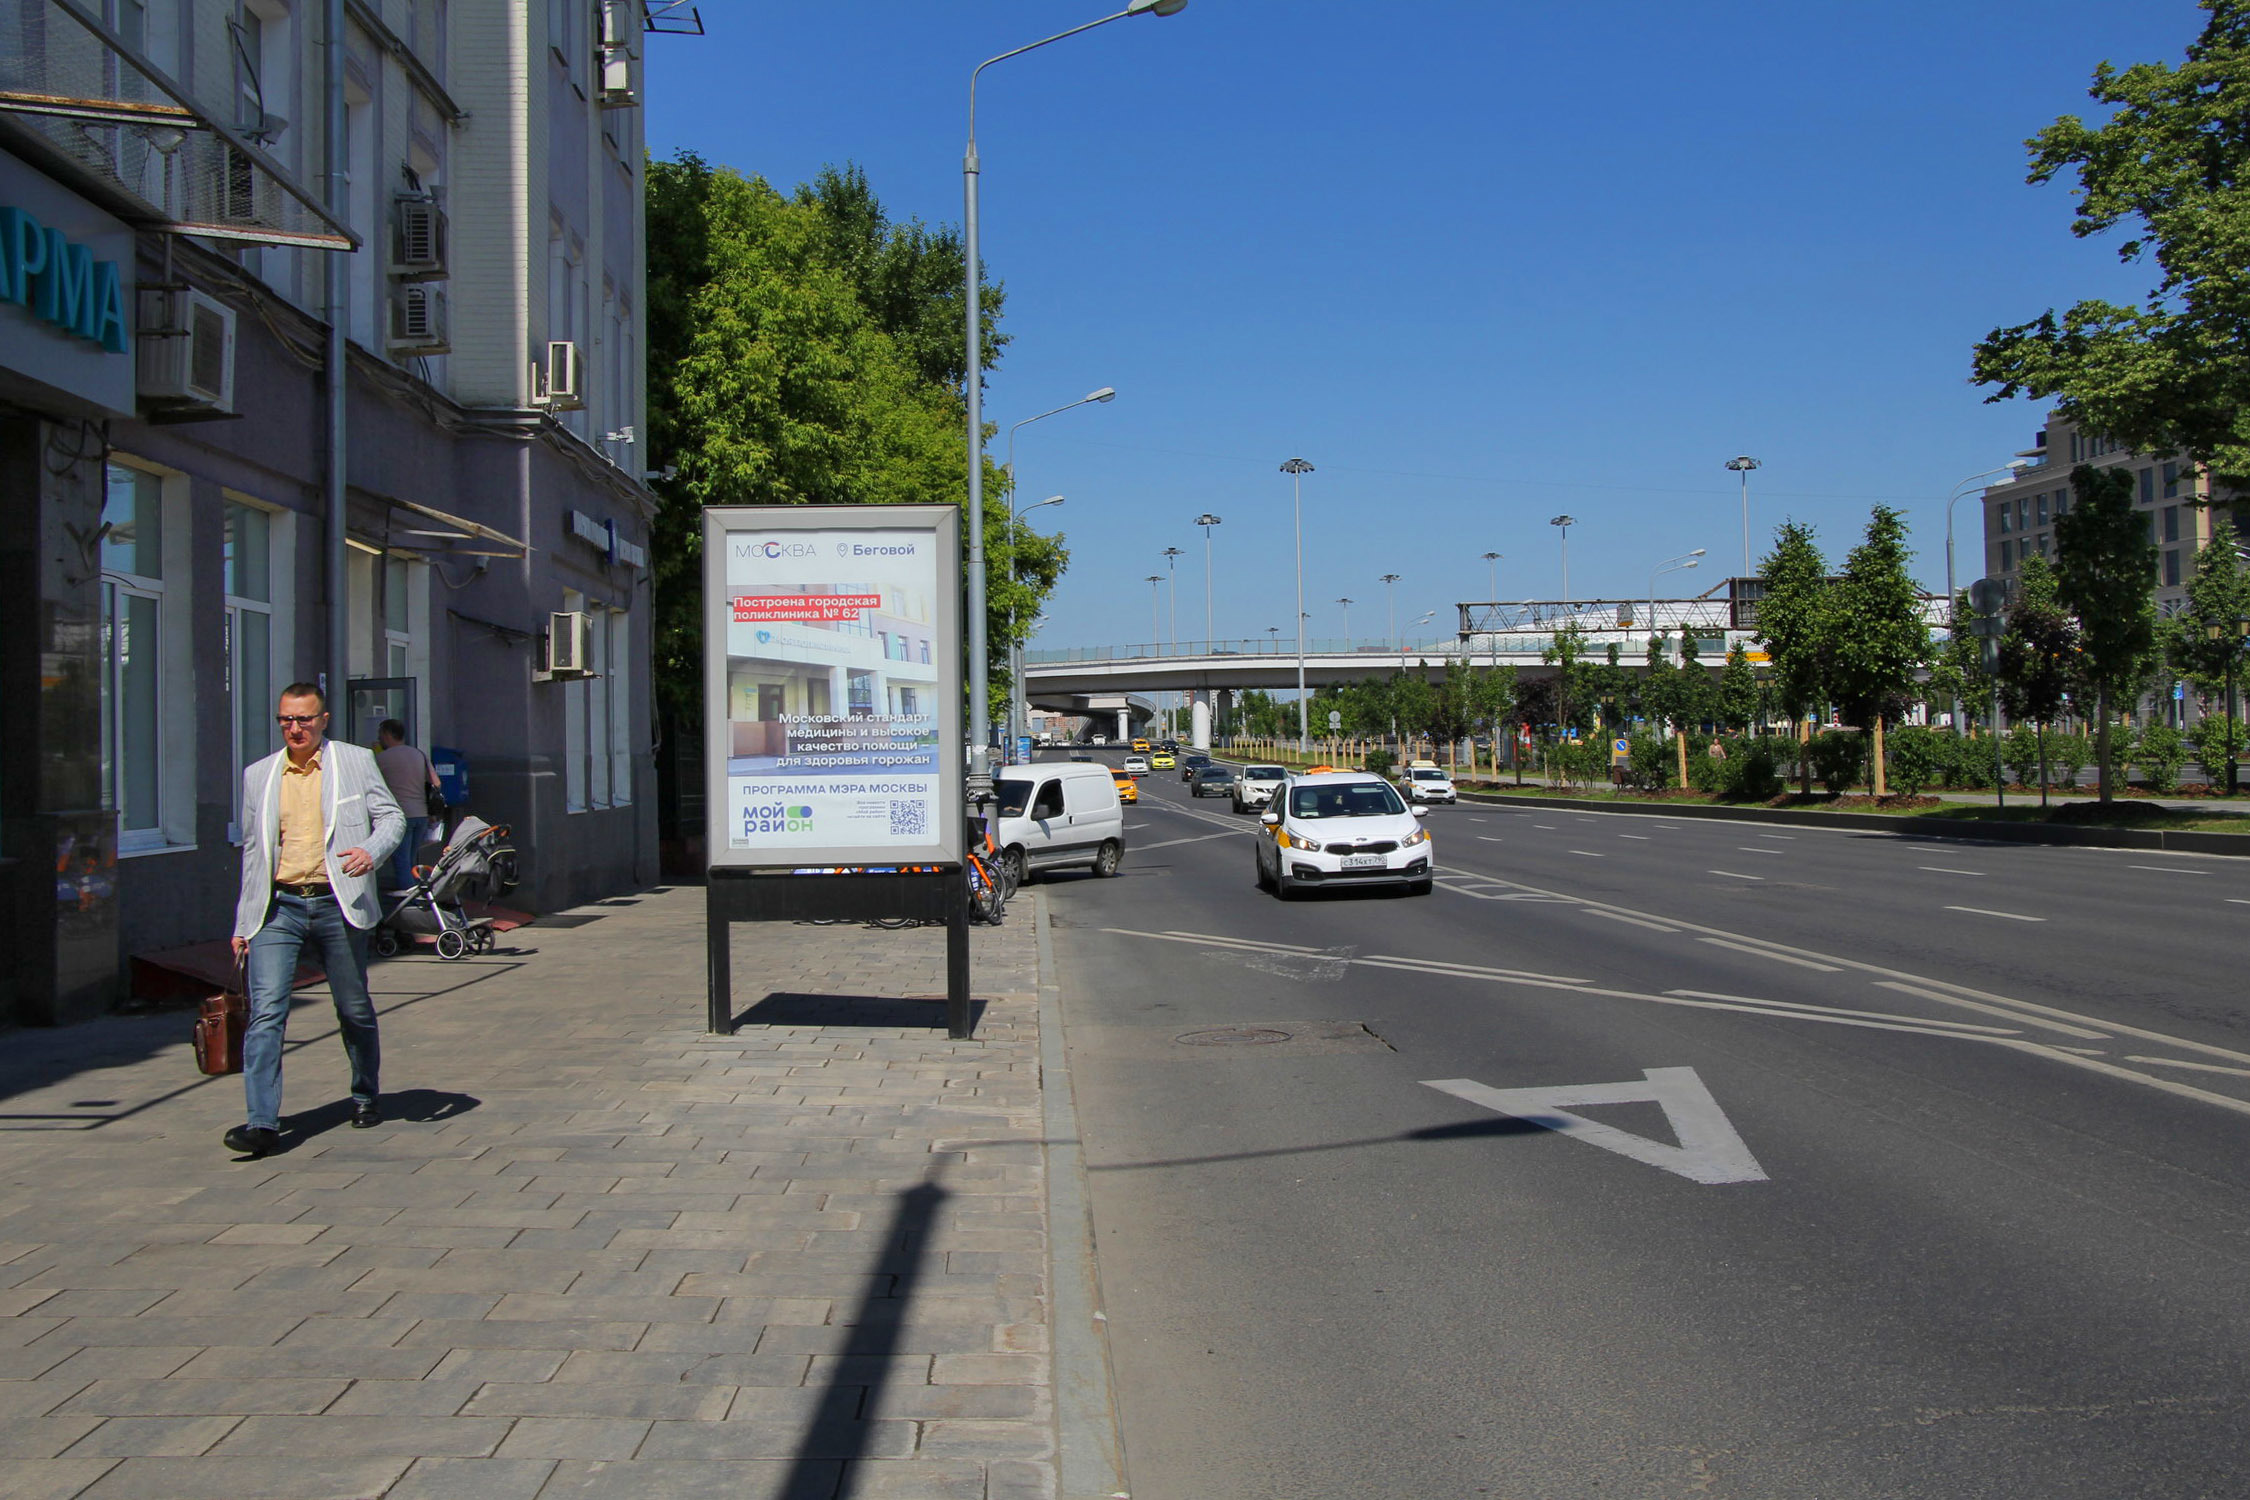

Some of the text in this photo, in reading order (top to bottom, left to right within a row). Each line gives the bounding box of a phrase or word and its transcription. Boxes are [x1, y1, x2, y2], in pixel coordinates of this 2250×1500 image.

[736, 541, 817, 559] МОСКВА
[853, 543, 915, 556] Беговой
[734, 597, 878, 609] Построена городская
[734, 610, 820, 620] поликлиника
[842, 608, 859, 618] 62
[778, 712, 929, 725] Московский стандарт
[787, 727, 930, 739] медицины и высокое
[797, 741, 860, 752] качество
[862, 741, 918, 751] помощи
[776, 755, 930, 767] для здоровья горожан
[743, 783, 928, 796] ПРОГРАММА МЭРА МОСКВЫ
